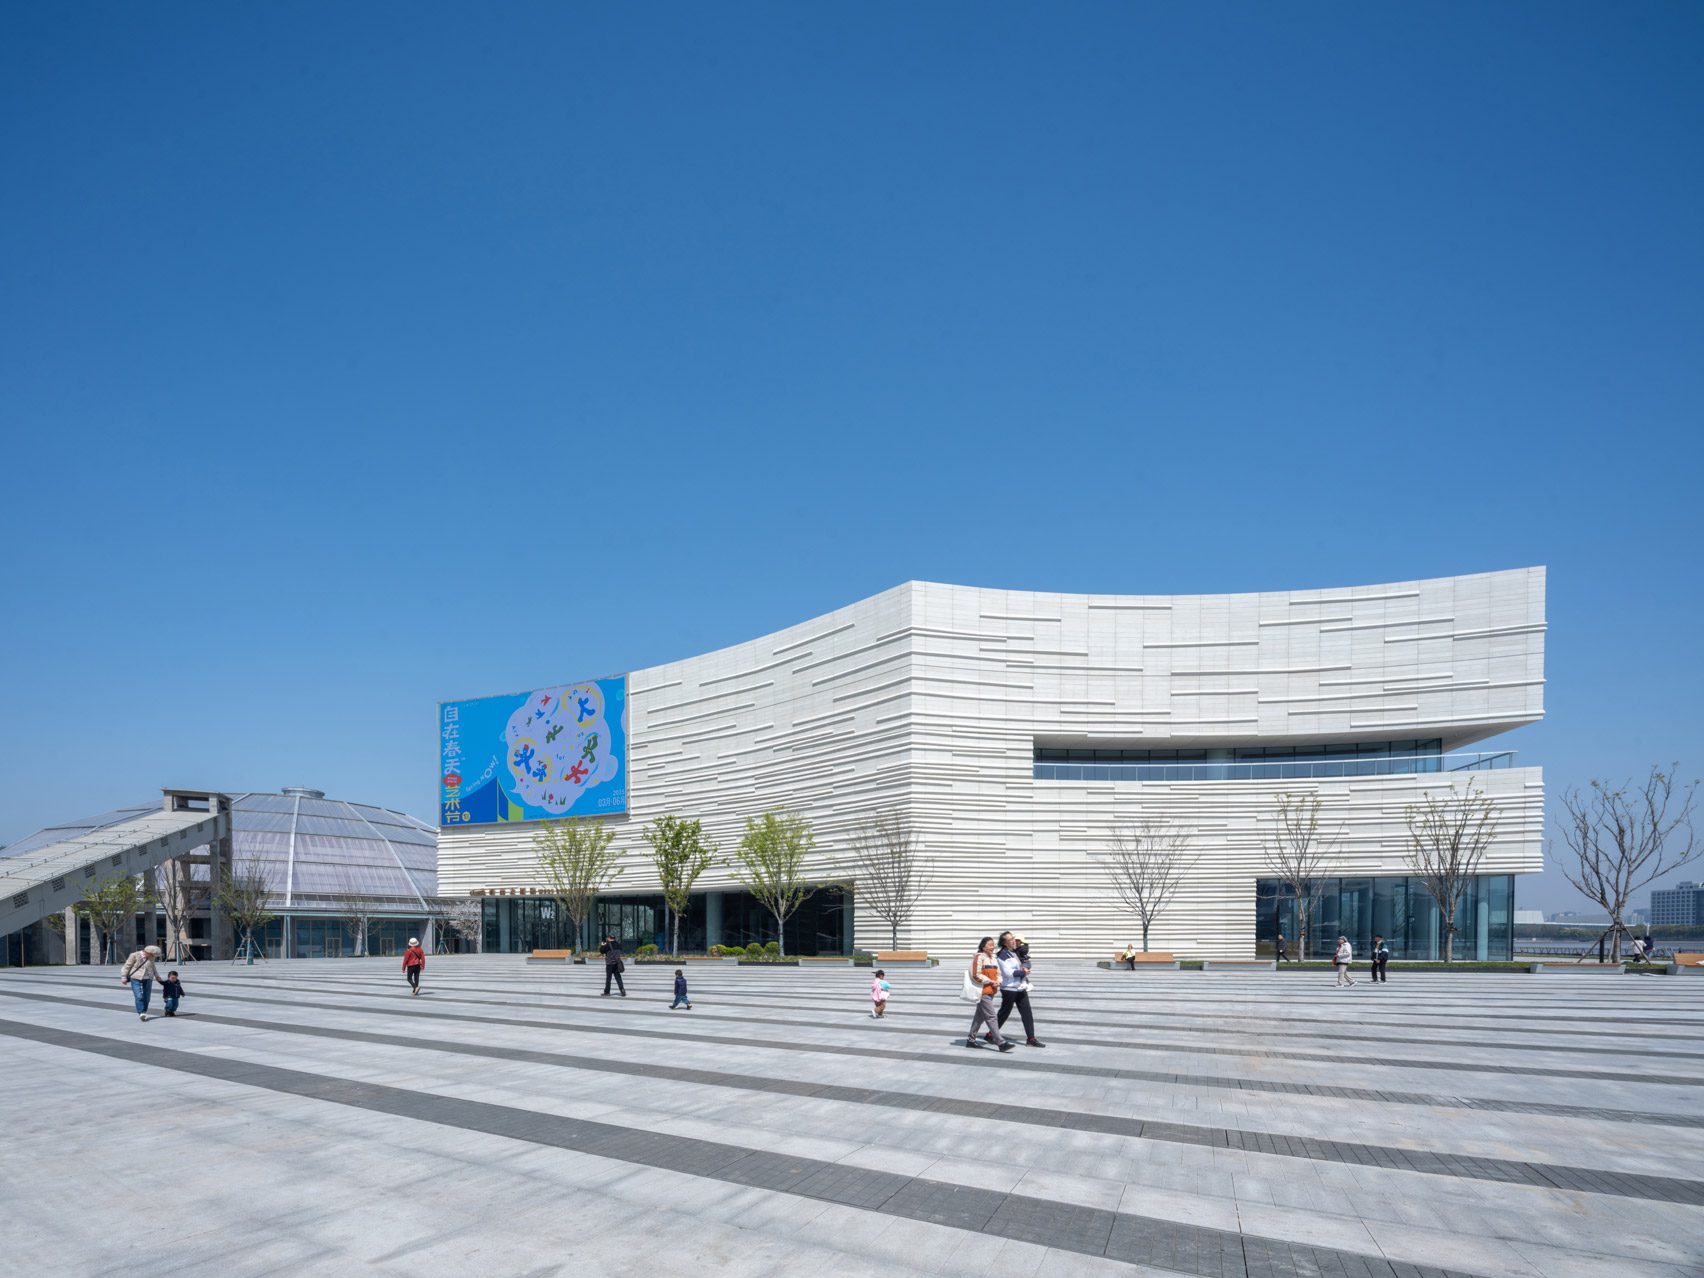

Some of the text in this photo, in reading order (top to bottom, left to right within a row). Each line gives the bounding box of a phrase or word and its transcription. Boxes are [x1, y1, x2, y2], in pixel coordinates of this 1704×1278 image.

[442, 706, 461, 774] 自在春天
[444, 786, 460, 823] 艺术节
